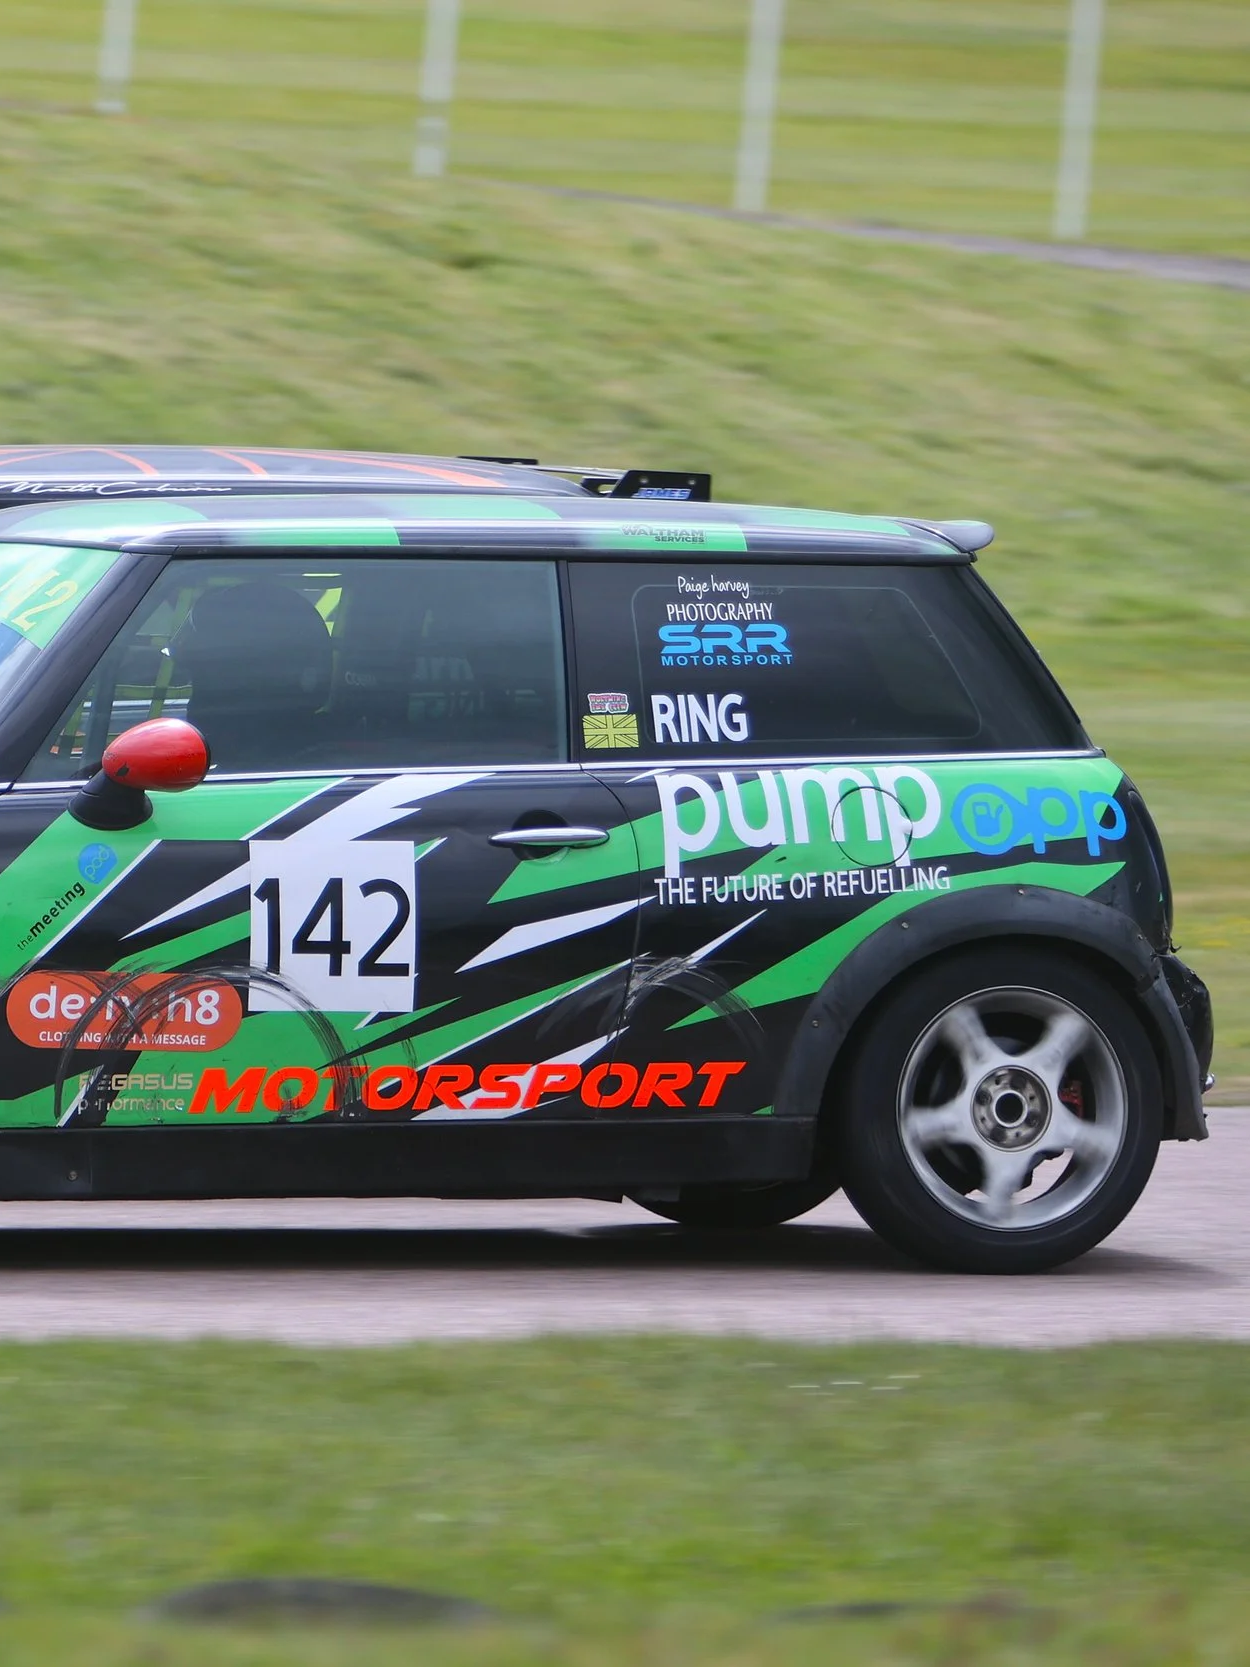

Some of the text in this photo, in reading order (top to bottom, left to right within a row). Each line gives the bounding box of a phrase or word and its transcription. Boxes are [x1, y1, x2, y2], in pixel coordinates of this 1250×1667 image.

[622, 527, 704, 537] WALTHAM
[654, 535, 704, 543] SERVICES
[677, 574, 750, 600] Paige harvey
[666, 602, 773, 622] PHOTOGRAPHY
[658, 623, 792, 655] SRR
[661, 654, 793, 667] MOTORSPORT
[650, 693, 749, 743] RING
[653, 765, 942, 879] pump
[654, 866, 951, 905] THE FUTURE OF REFUELLING
[254, 878, 410, 977] 142
[39, 1030, 101, 1043] CLOTING
[152, 1033, 207, 1046] MESSAGE
[187, 1060, 747, 1115] MOTORSPORT
